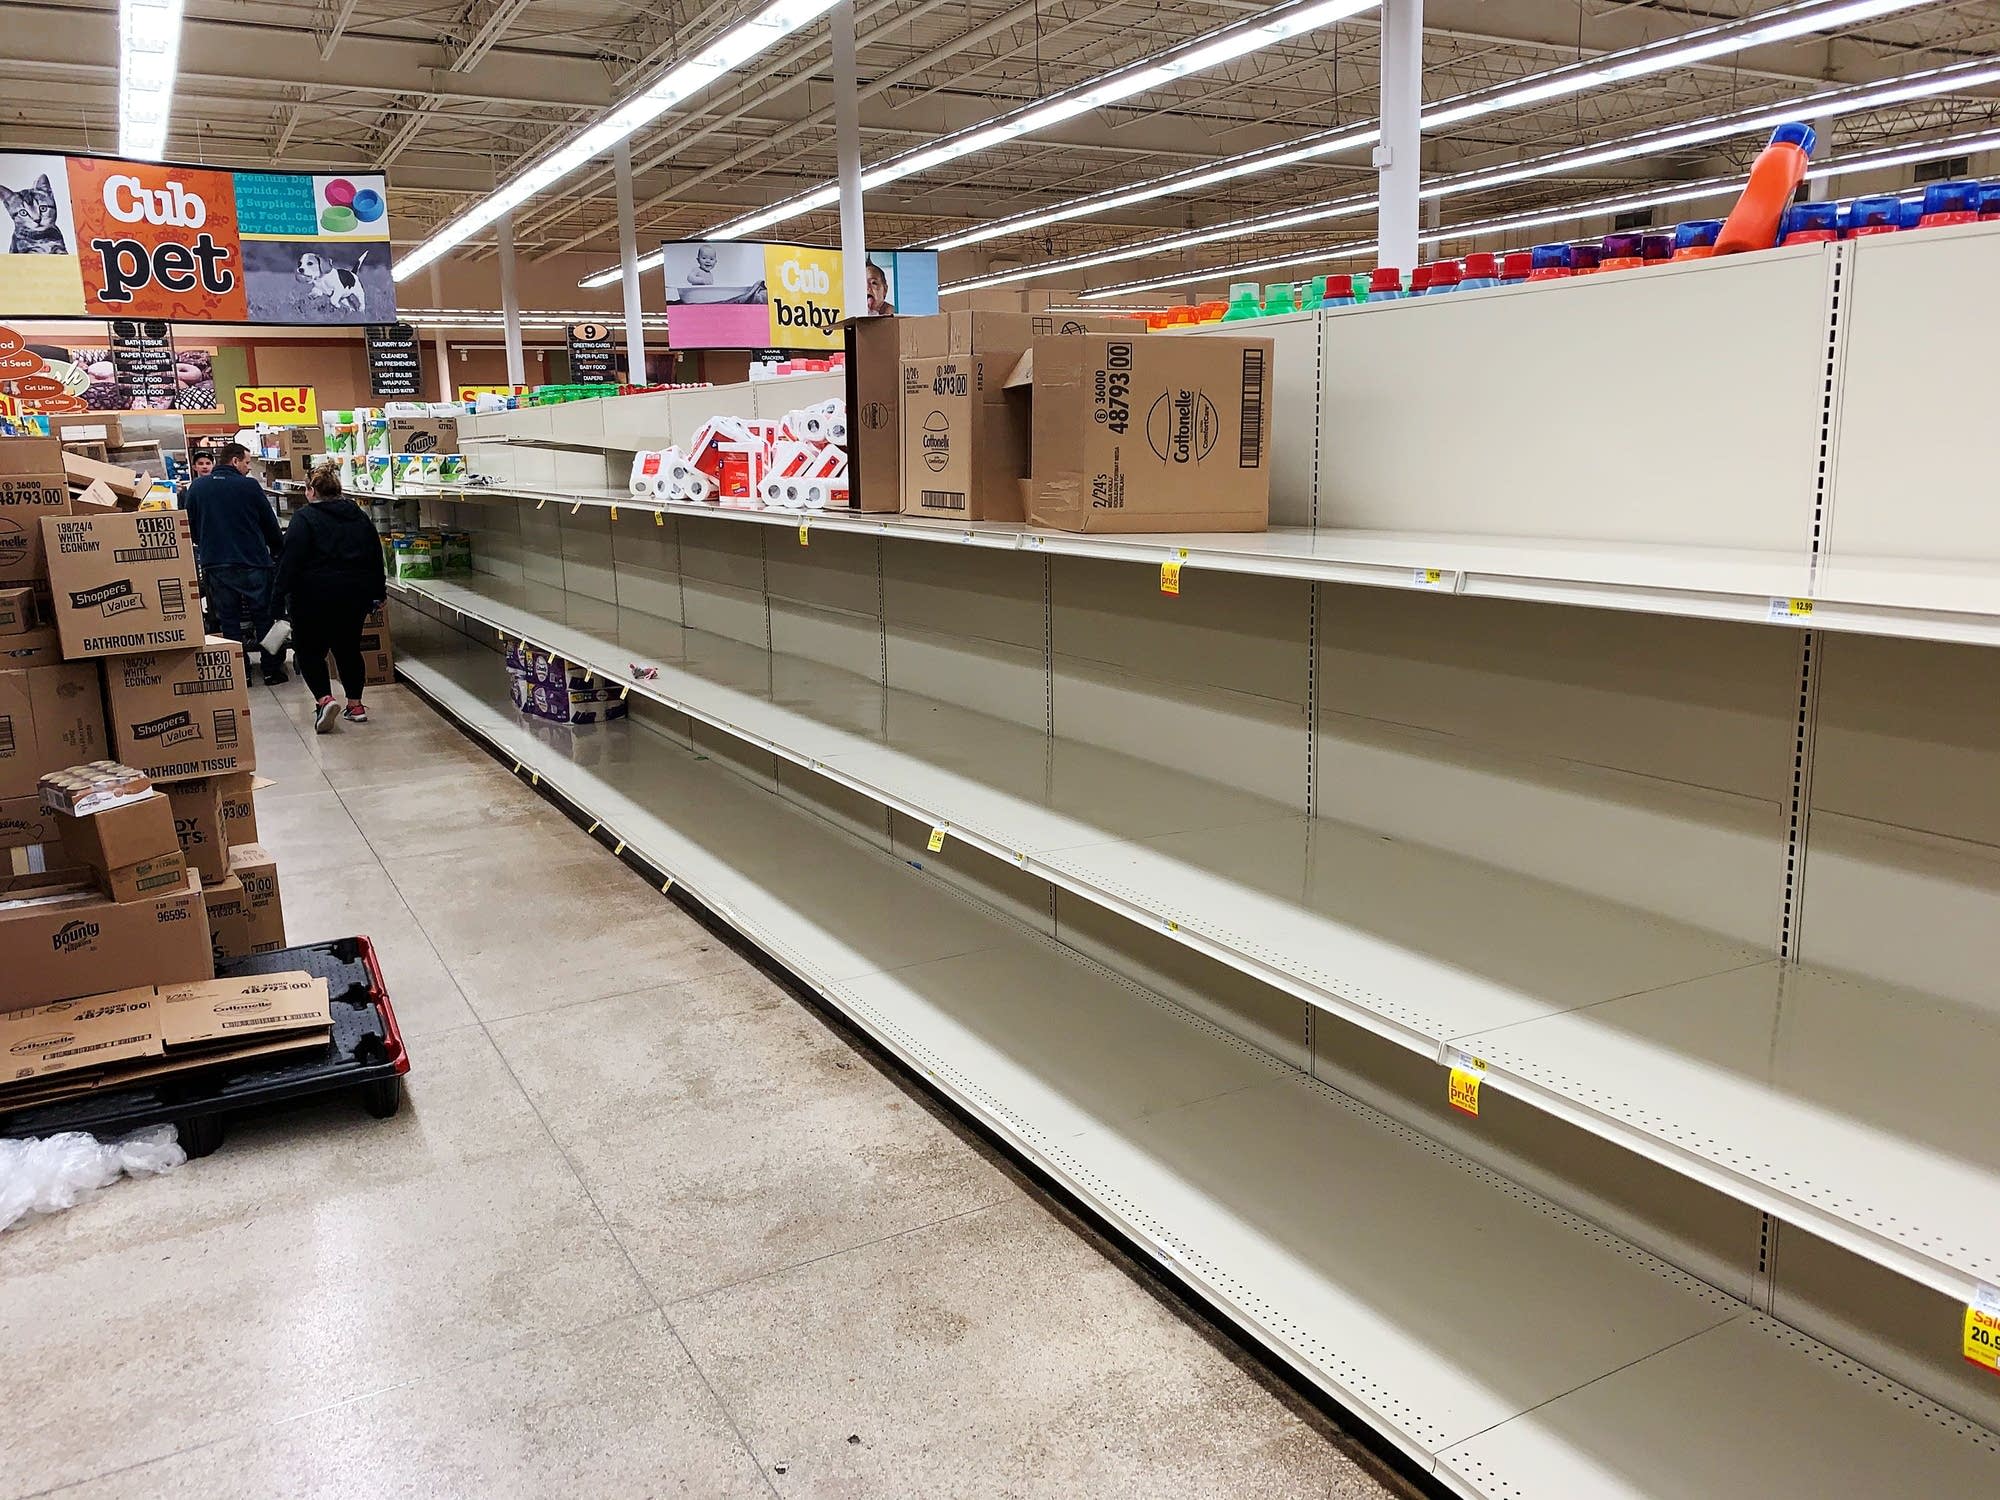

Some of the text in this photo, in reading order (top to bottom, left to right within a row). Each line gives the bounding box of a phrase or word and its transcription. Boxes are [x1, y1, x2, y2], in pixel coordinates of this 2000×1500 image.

[291, 175, 312, 185] Dog
[102, 174, 206, 228] Cub
[240, 223, 261, 233] Dry
[265, 224, 284, 232] Cat
[91, 233, 234, 302] pet
[782, 260, 829, 294] Cub
[774, 298, 840, 336] baby
[584, 325, 596, 339] 9
[956, 376, 966, 394] 00
[1096, 370, 1106, 404] 36000
[1109, 346, 1130, 434] 48793 00
[240, 389, 307, 413] Sale!
[1174, 389, 1192, 464] Cottonelle
[404, 435, 437, 453] Bounty
[45, 491, 60, 503] 00
[1092, 474, 1107, 508] 2/24's
[56, 522, 92, 533] 198/24/4
[138, 518, 173, 532] 41130
[0, 536, 27, 546] nelle
[58, 533, 85, 543] WHITE
[139, 532, 177, 547] 31128
[60, 541, 100, 553] ECONOMY
[1162, 577, 1177, 587] price
[77, 584, 127, 605] Shoppers
[107, 598, 136, 612] Value
[1796, 602, 1812, 611] 12.99
[83, 630, 186, 651] BATHROOM TISSUE
[197, 651, 230, 666] 41130
[123, 667, 148, 677] WHITE
[198, 665, 232, 680] 31128
[125, 676, 161, 687] ECONOMY
[138, 715, 185, 736] Shoppers
[167, 728, 193, 742] Value
[143, 757, 237, 778] BATHROOM TISSUE
[175, 818, 198, 832] DY
[258, 880, 272, 891] 00
[158, 908, 187, 922] 96595
[52, 922, 99, 950] Bounty
[241, 985, 288, 994] 48793
[73, 1002, 147, 1020] 48793 00
[213, 1001, 272, 1013] Cottonelle
[10, 1035, 76, 1052] Cottonelle
[1451, 1088, 1476, 1105] price
